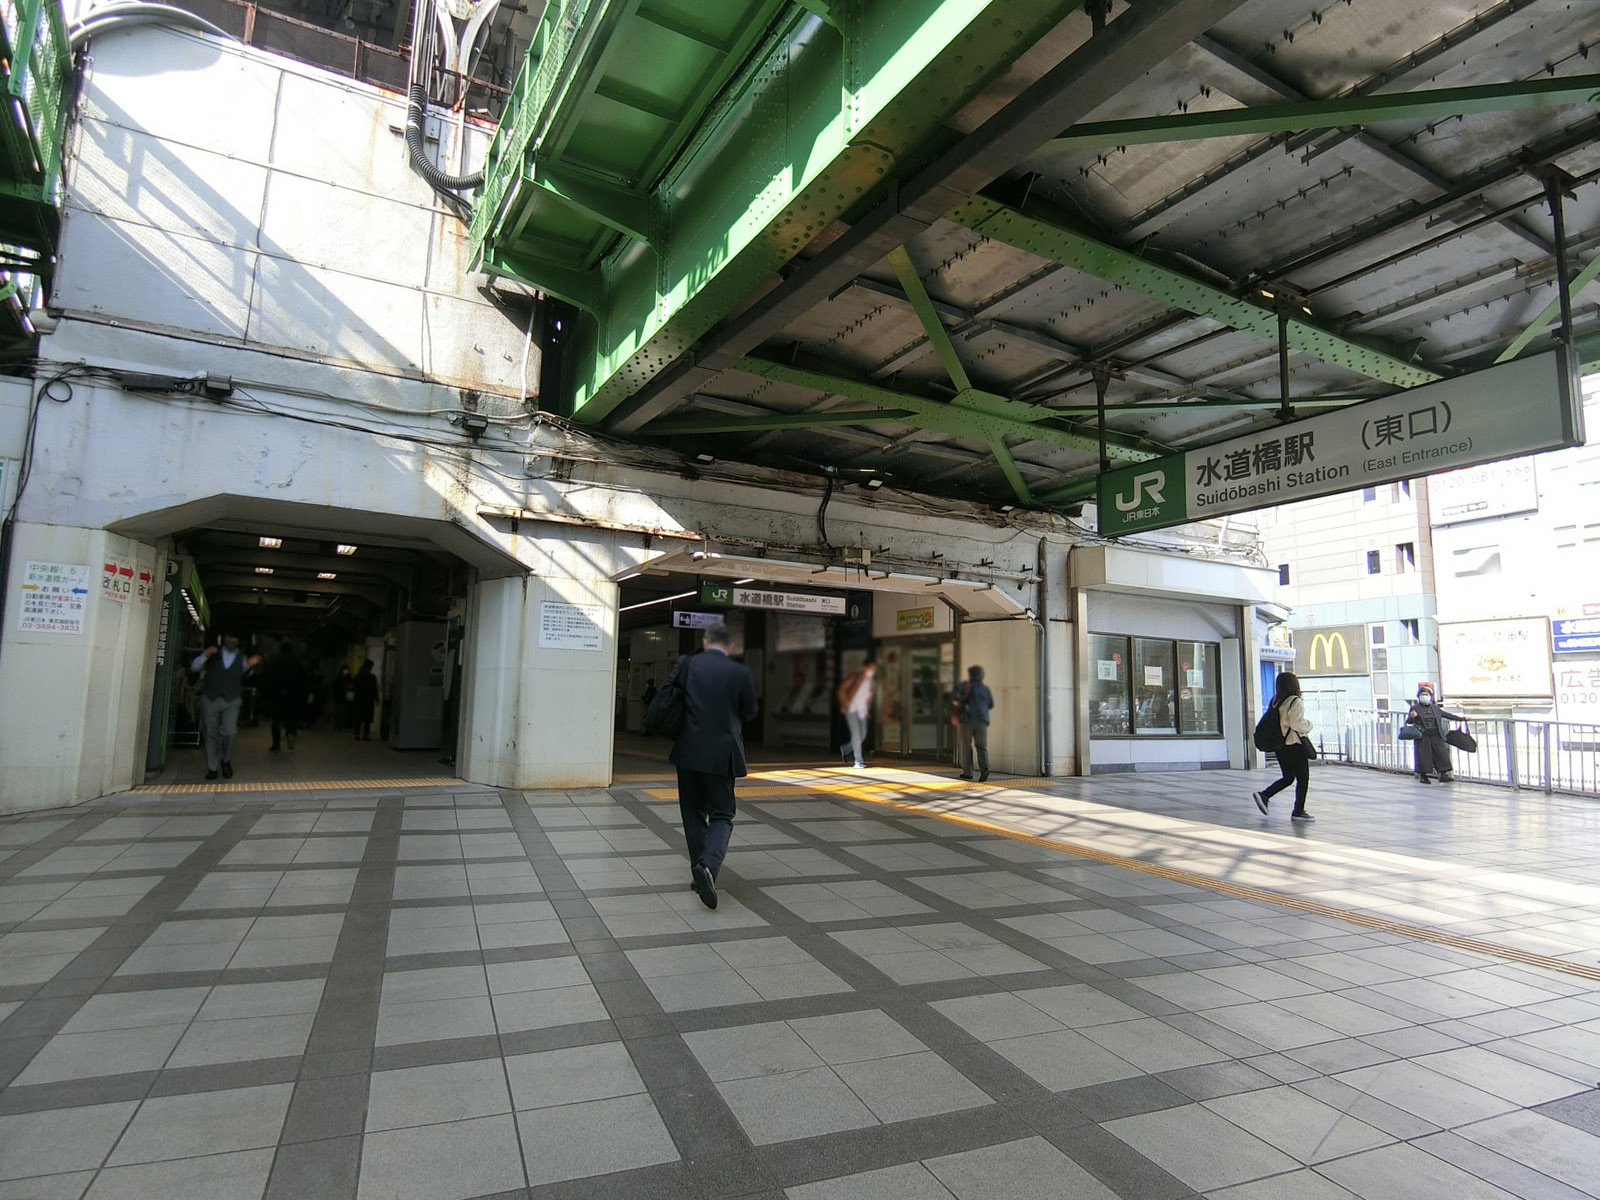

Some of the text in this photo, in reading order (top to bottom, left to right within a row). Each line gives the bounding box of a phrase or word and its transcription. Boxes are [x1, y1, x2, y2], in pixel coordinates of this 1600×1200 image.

[1196, 401, 1452, 487] 水道橋駅 (東口)
[1363, 437, 1473, 473] (East Entrance)
[1115, 470, 1166, 511] JR
[1196, 464, 1350, 507] Suidōbashi Station
[1122, 506, 1160, 523] JR東日本
[102, 576, 131, 594] 改札口
[711, 589, 728, 600] JR
[740, 591, 785, 607] 水道橋駅
